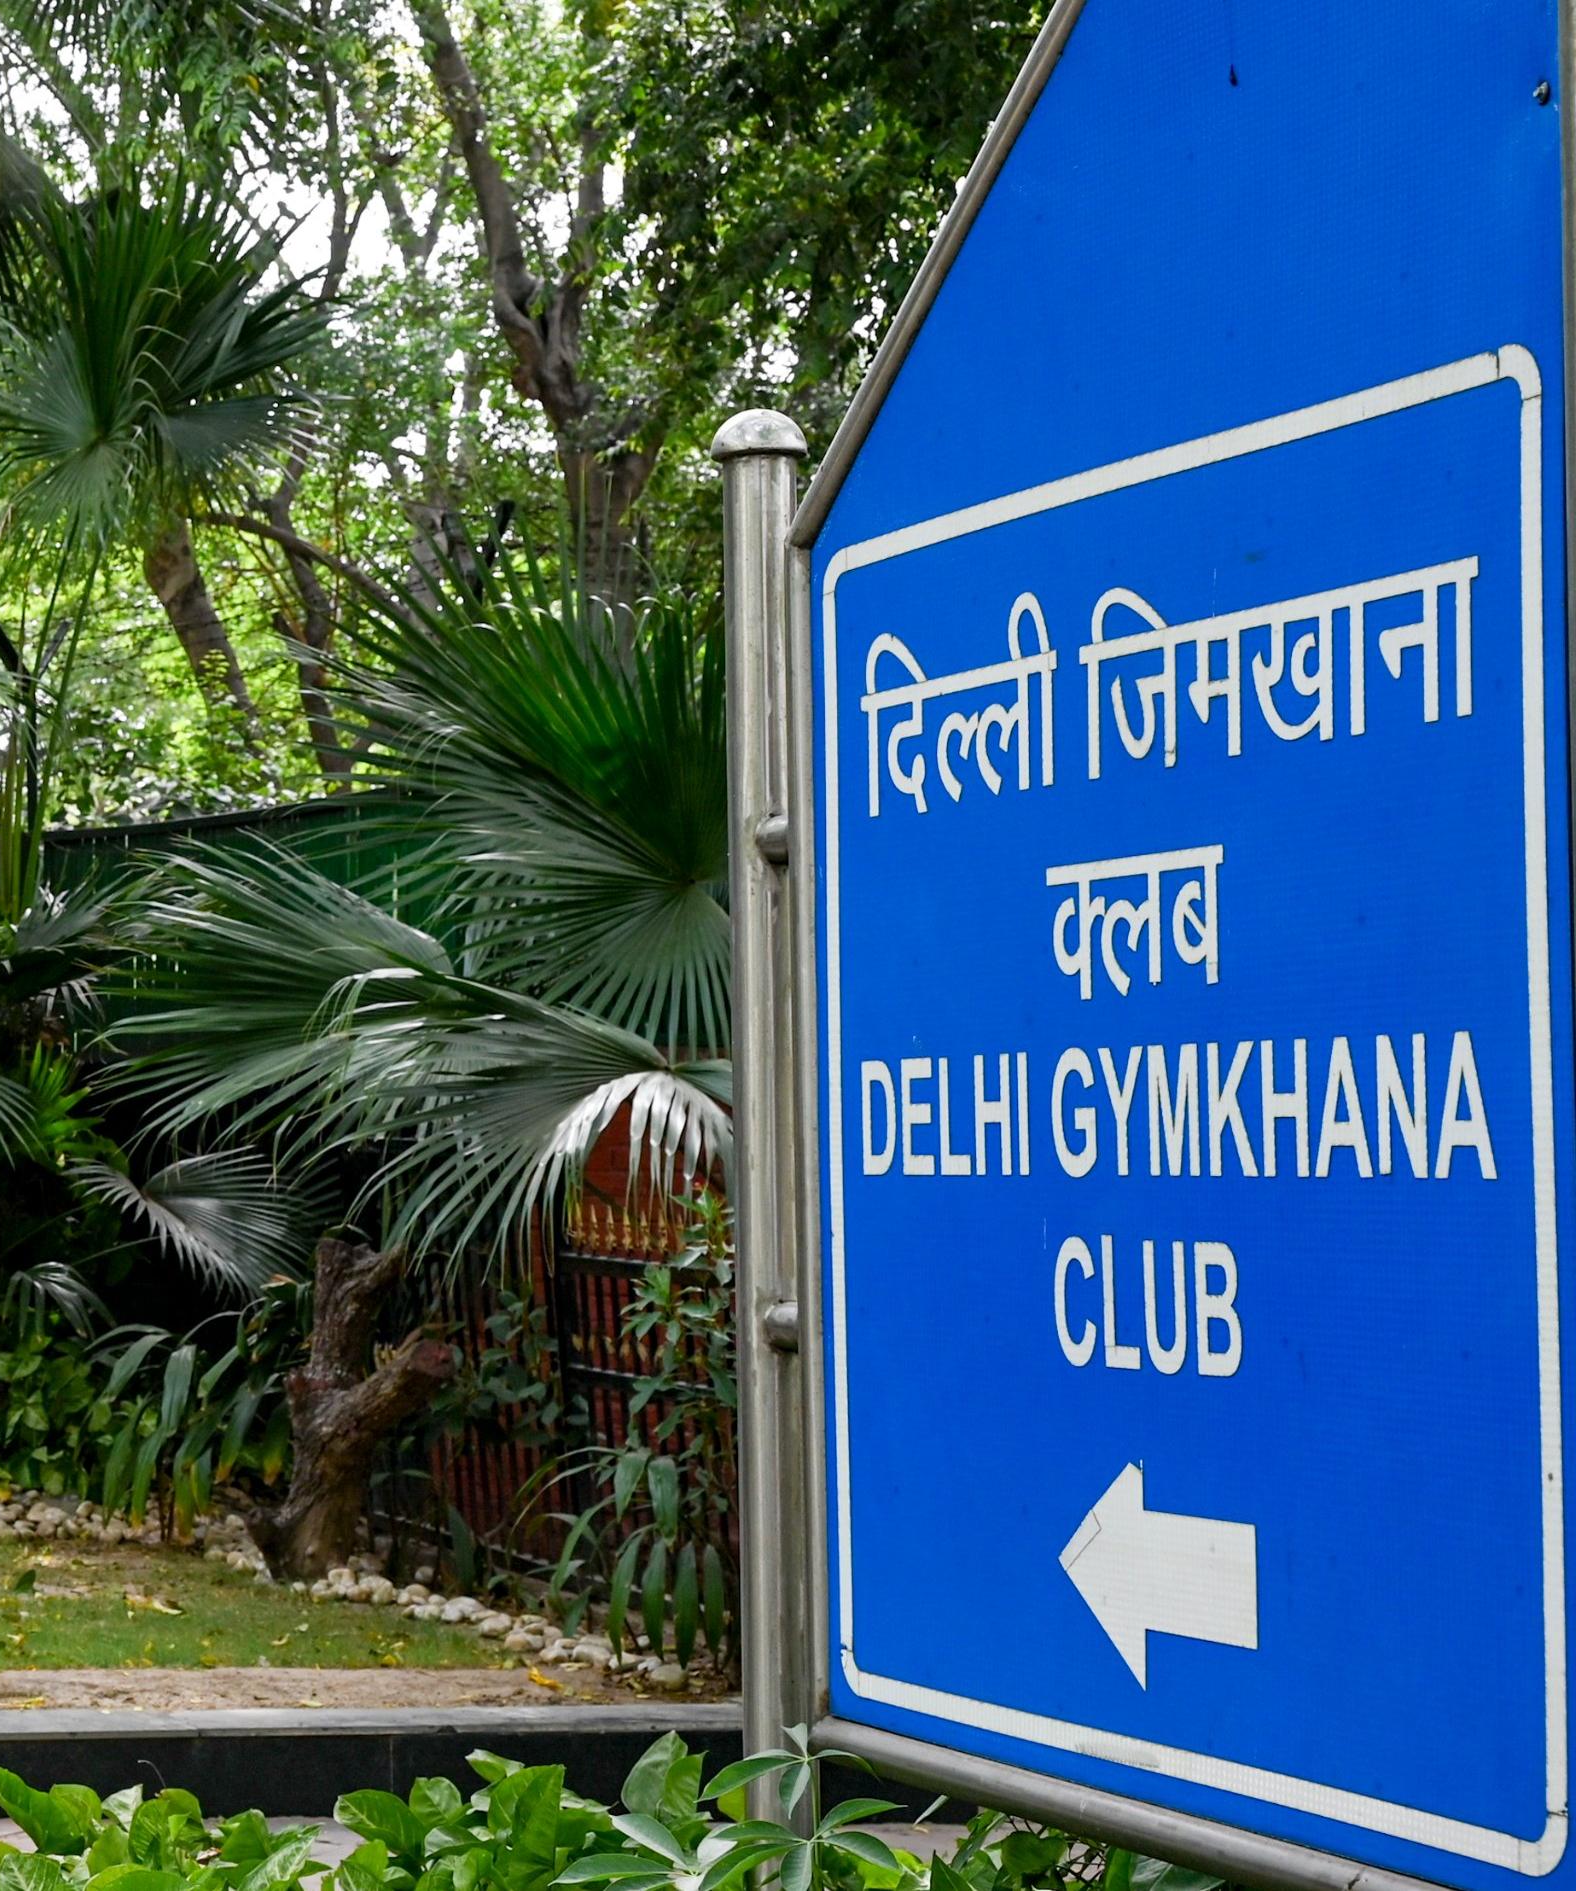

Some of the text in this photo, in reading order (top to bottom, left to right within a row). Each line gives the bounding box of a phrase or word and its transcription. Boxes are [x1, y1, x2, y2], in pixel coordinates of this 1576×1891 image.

[861, 556, 1478, 816] दिल्ली जिमखाना
[1046, 845, 1223, 999] क्लब
[862, 1032, 1496, 1179] DELHI GYMKHANA
[1055, 1235, 1241, 1376] CLUB
